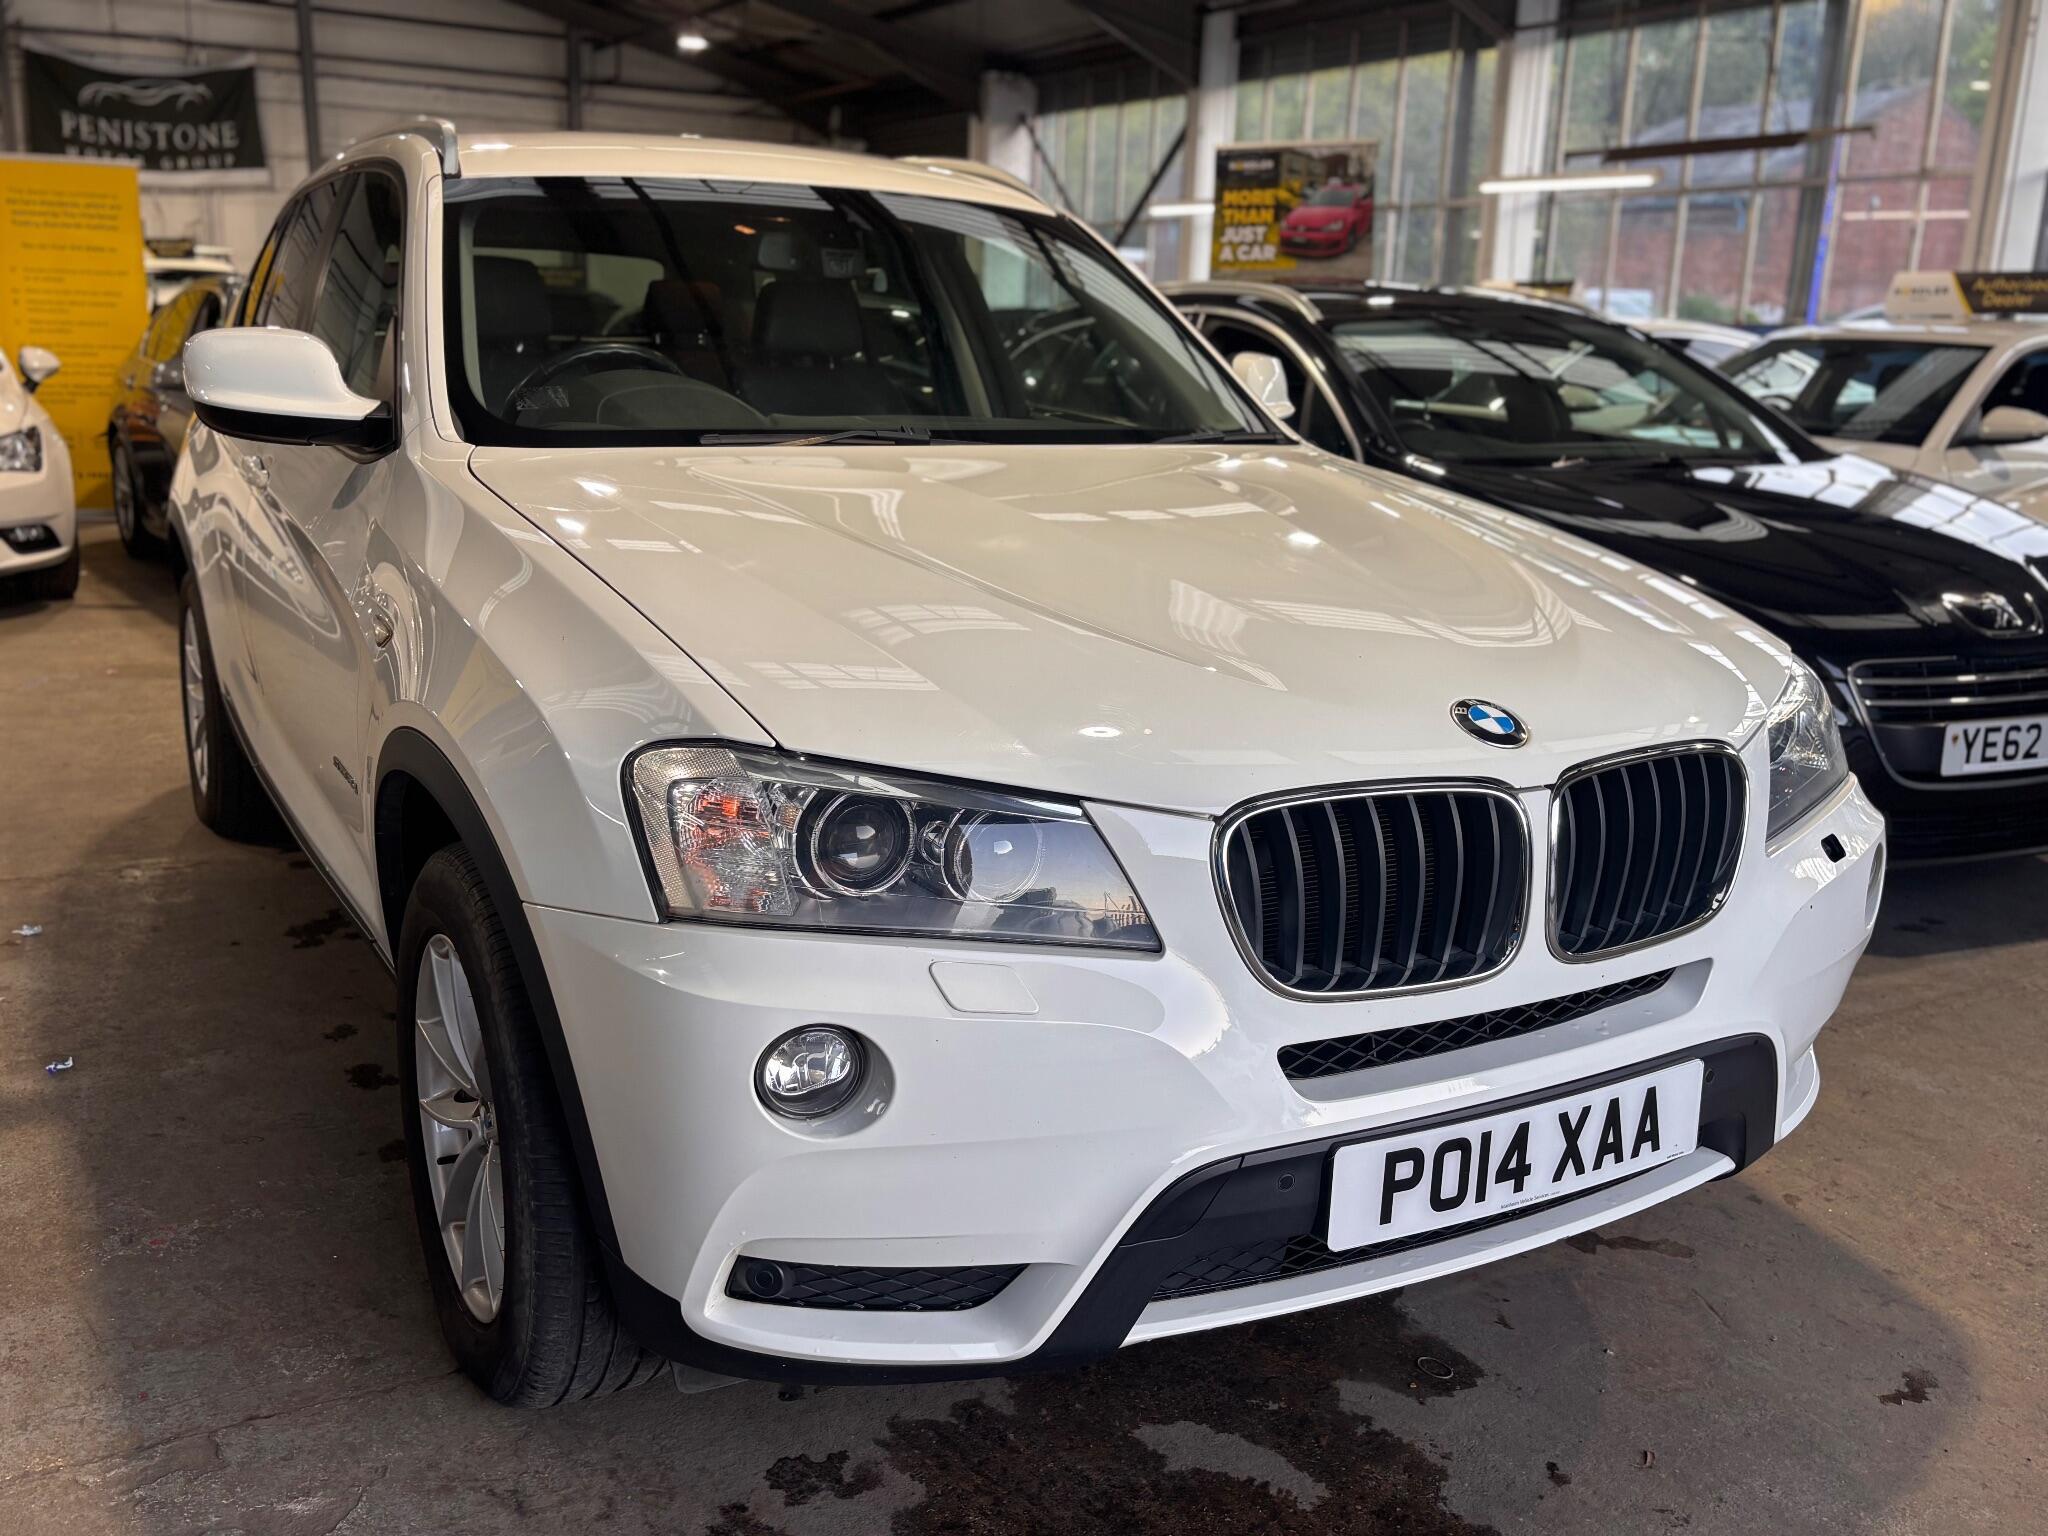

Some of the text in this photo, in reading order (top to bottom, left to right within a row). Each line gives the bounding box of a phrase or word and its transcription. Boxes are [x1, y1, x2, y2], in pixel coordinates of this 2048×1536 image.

[60, 109, 240, 151] PENISTONE
[1223, 189, 1275, 206] MORE
[1222, 207, 1275, 224] THAN
[1220, 225, 1268, 244] JUST
[1219, 244, 1277, 262] A CAR
[1963, 723, 2042, 764] YE62
[1379, 1085, 1661, 1226] PO14 XAA
